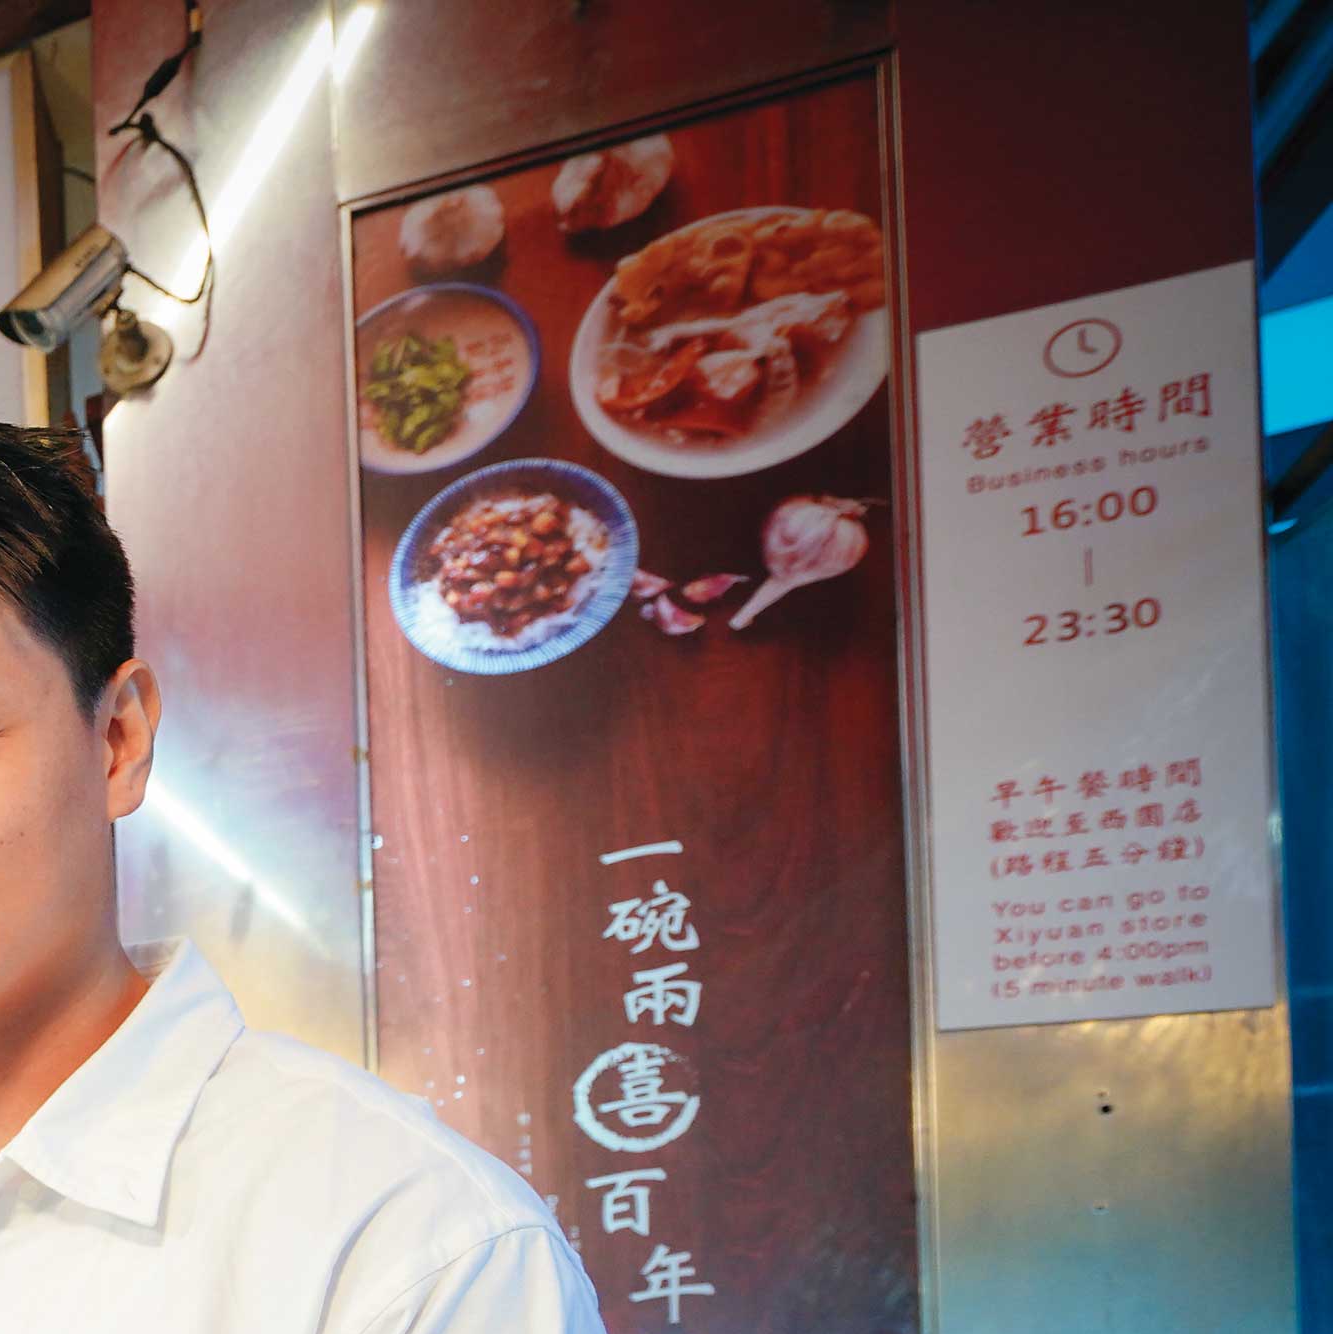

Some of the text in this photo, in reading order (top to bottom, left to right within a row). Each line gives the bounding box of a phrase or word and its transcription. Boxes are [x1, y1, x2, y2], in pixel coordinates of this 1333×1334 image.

[961, 372, 1213, 461] 營業時間
[966, 436, 1211, 495] Business hours
[1021, 485, 1159, 537] 16:00
[1022, 597, 1162, 647] 23:30
[989, 757, 1202, 809] 早午餐時間
[991, 885, 1210, 918] You can go to
[995, 913, 1208, 946] Xiyuan store
[993, 951, 1085, 972] before
